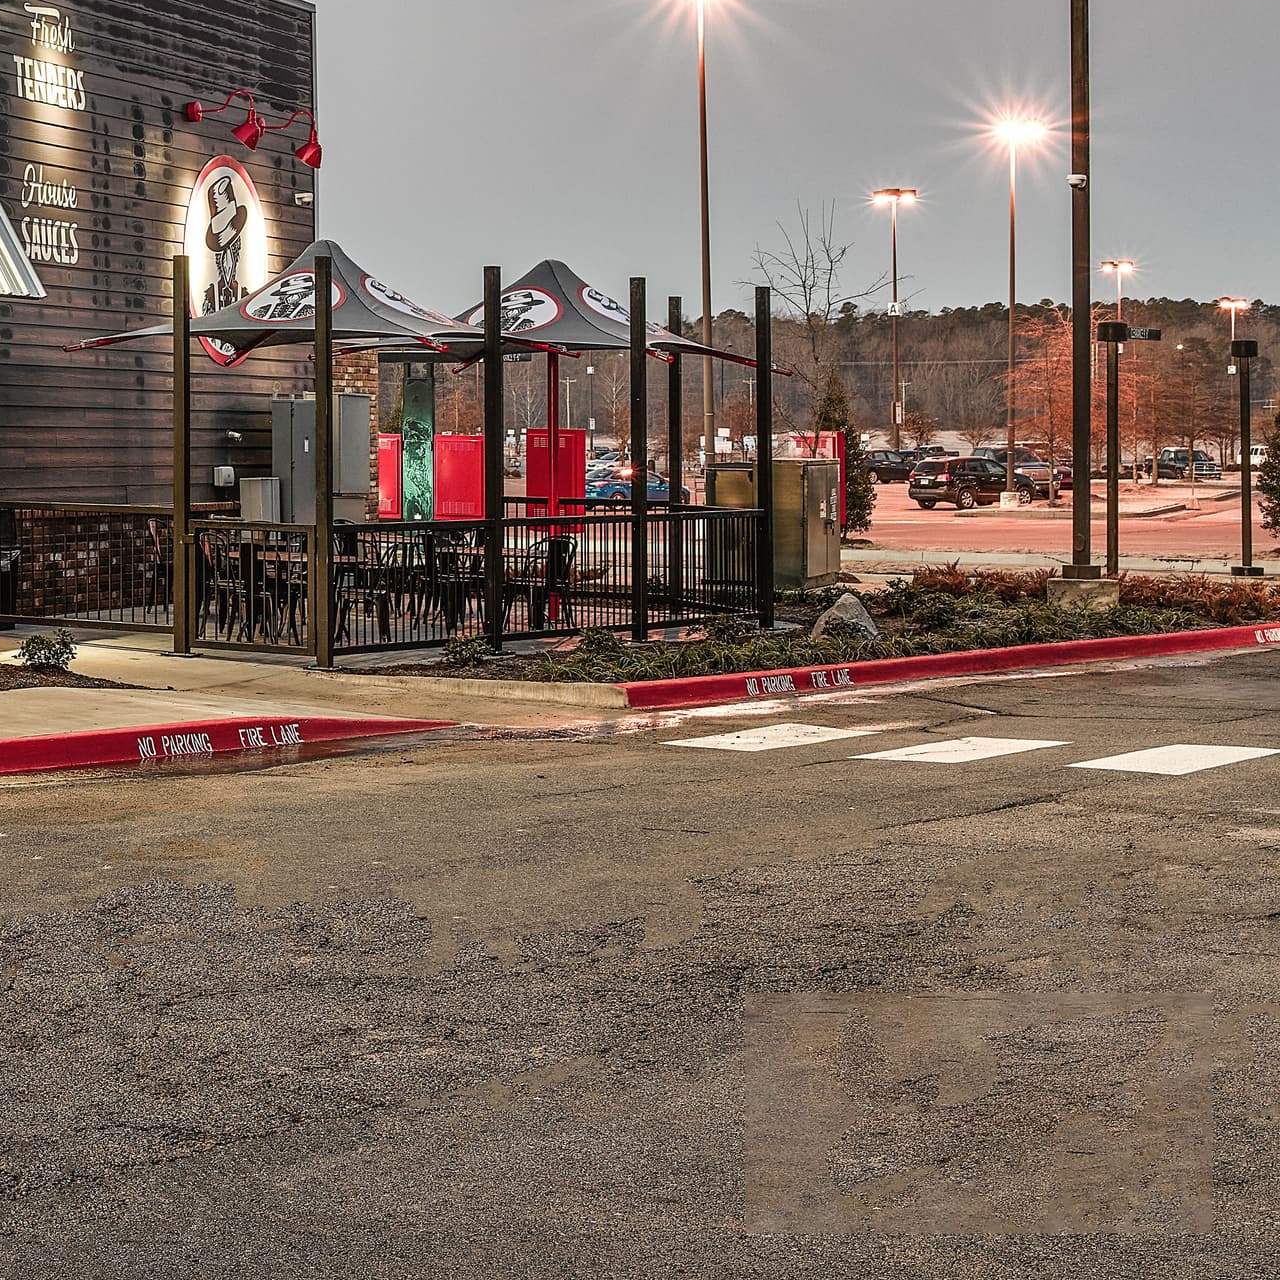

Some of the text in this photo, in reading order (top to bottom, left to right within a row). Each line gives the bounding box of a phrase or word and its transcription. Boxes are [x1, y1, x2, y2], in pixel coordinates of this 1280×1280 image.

[23, 2, 76, 55] Fresh
[13, 54, 86, 111] TENDERS
[21, 216, 79, 265] SAUCES
[889, 303, 897, 315] A
[746, 669, 854, 697] NO PARKING FIRE LANE
[137, 724, 305, 758] NO PARKING FIRE LANE
